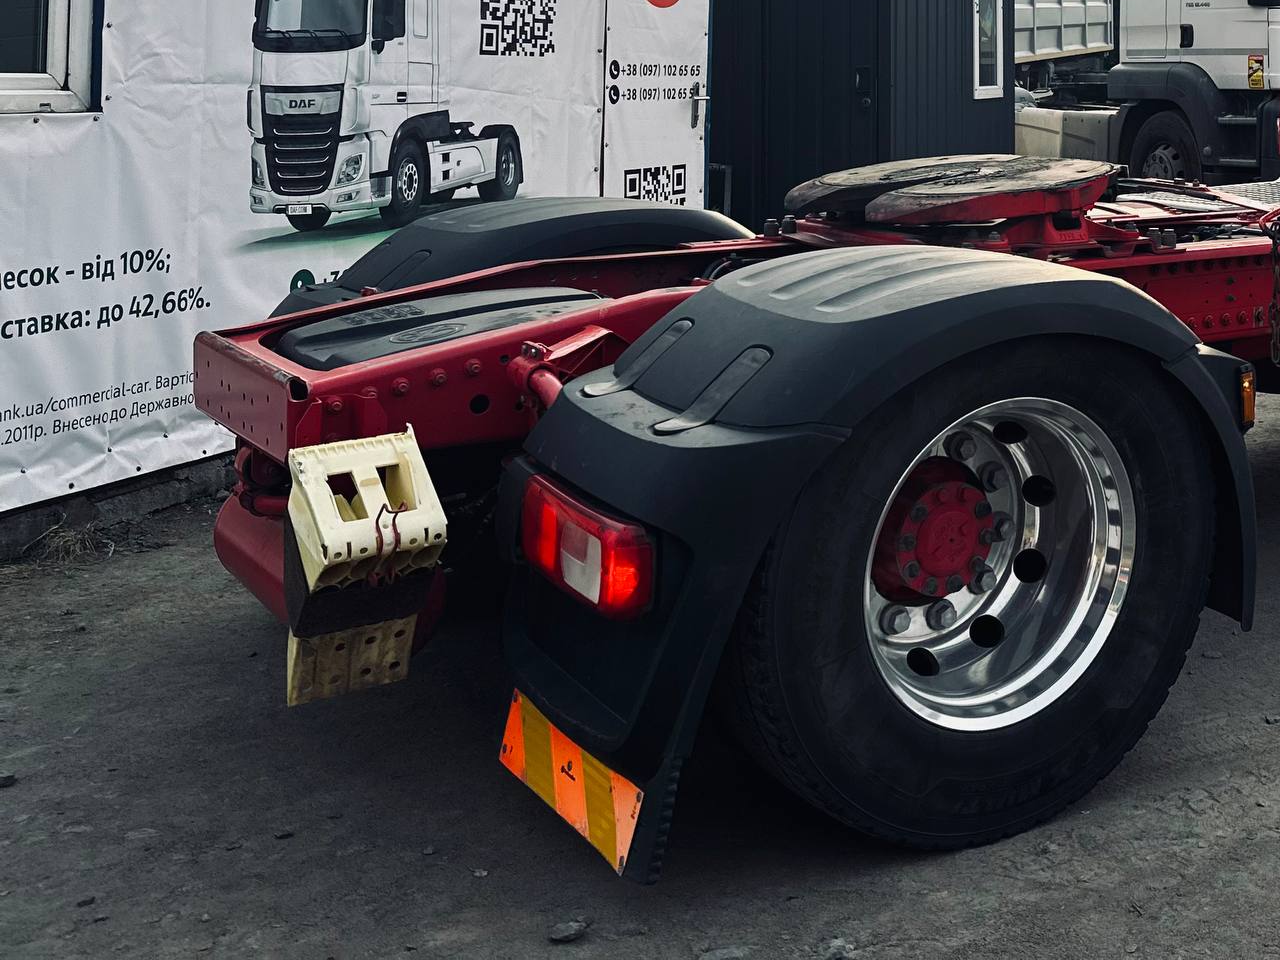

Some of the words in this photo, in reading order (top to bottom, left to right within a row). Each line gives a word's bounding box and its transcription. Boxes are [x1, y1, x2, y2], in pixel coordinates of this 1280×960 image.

[621, 64, 637, 76] +38
[640, 62, 661, 78] (097)
[663, 64, 677, 77] 102
[679, 65, 688, 76] 65
[690, 65, 701, 76] 65
[621, 88, 637, 100] +38
[640, 87, 660, 101] (097)
[662, 88, 676, 100] 102
[678, 88, 687, 99] 65
[289, 99, 316, 109] DAF
[0, 265, 60, 291] есок
[81, 254, 115, 283] від
[120, 248, 171, 276] 10%;
[0, 308, 91, 340] ставка:
[97, 303, 124, 330] до
[129, 286, 211, 319] 42,66%.
